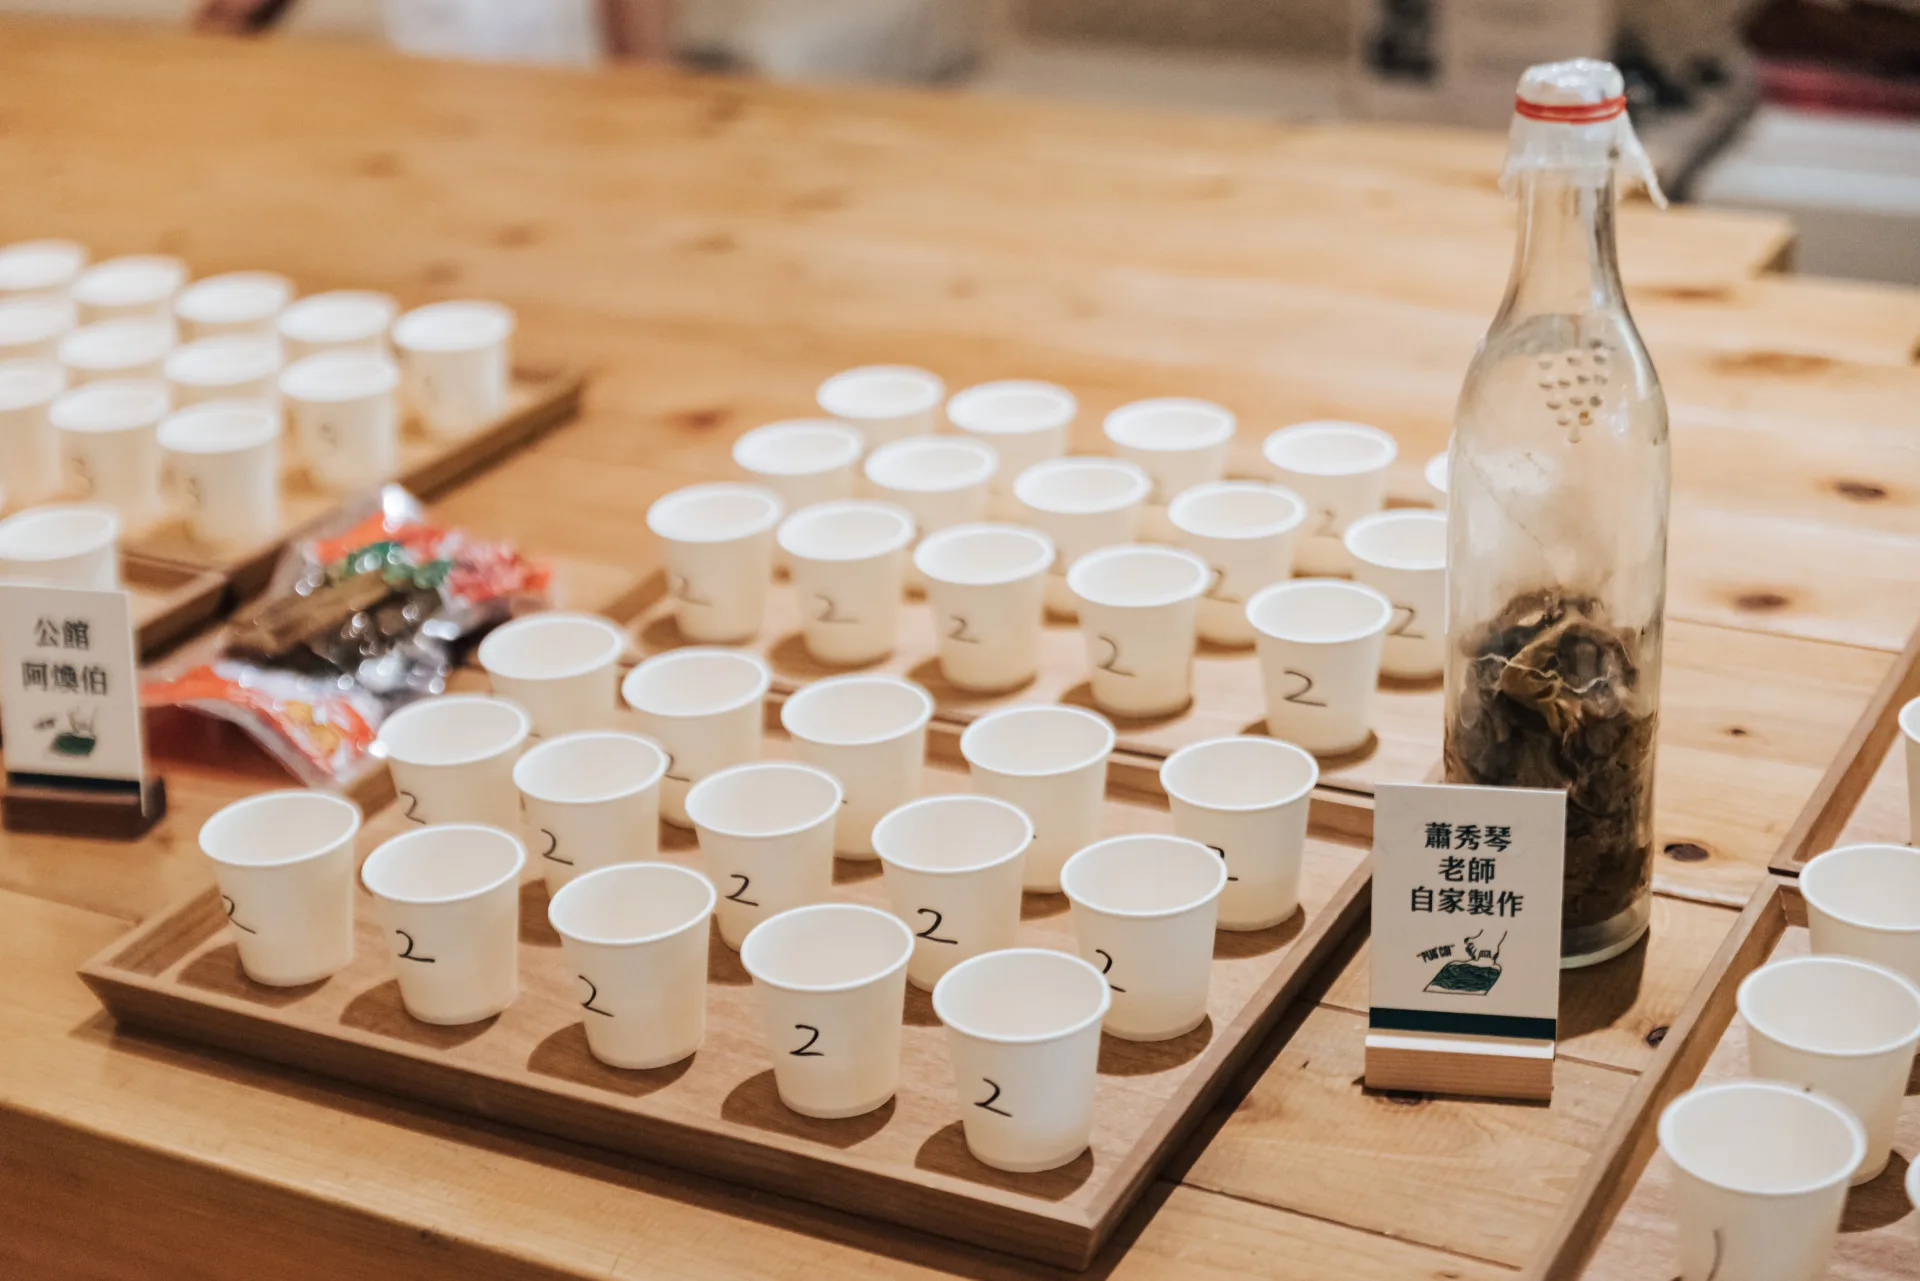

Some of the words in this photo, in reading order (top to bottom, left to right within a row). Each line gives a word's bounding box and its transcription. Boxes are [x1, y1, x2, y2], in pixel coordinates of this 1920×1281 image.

[815, 592, 859, 624] 2
[1387, 605, 1425, 639] 2
[33, 618, 90, 650] 公館
[948, 616, 980, 643] 2
[1097, 635, 1137, 677] 2
[1283, 670, 1328, 707] 2
[401, 791, 426, 824] 2
[541, 829, 574, 865] 2
[1424, 822, 1512, 852] 蕭秀琴
[1438, 856, 1496, 884] 老師
[725, 874, 759, 907] 2
[1411, 886, 1524, 918] 自家製作
[916, 908, 958, 944] 2
[396, 930, 435, 963] 2
[578, 974, 615, 1018] 2
[789, 1024, 824, 1056] 2
[974, 1078, 1013, 1117] 2
